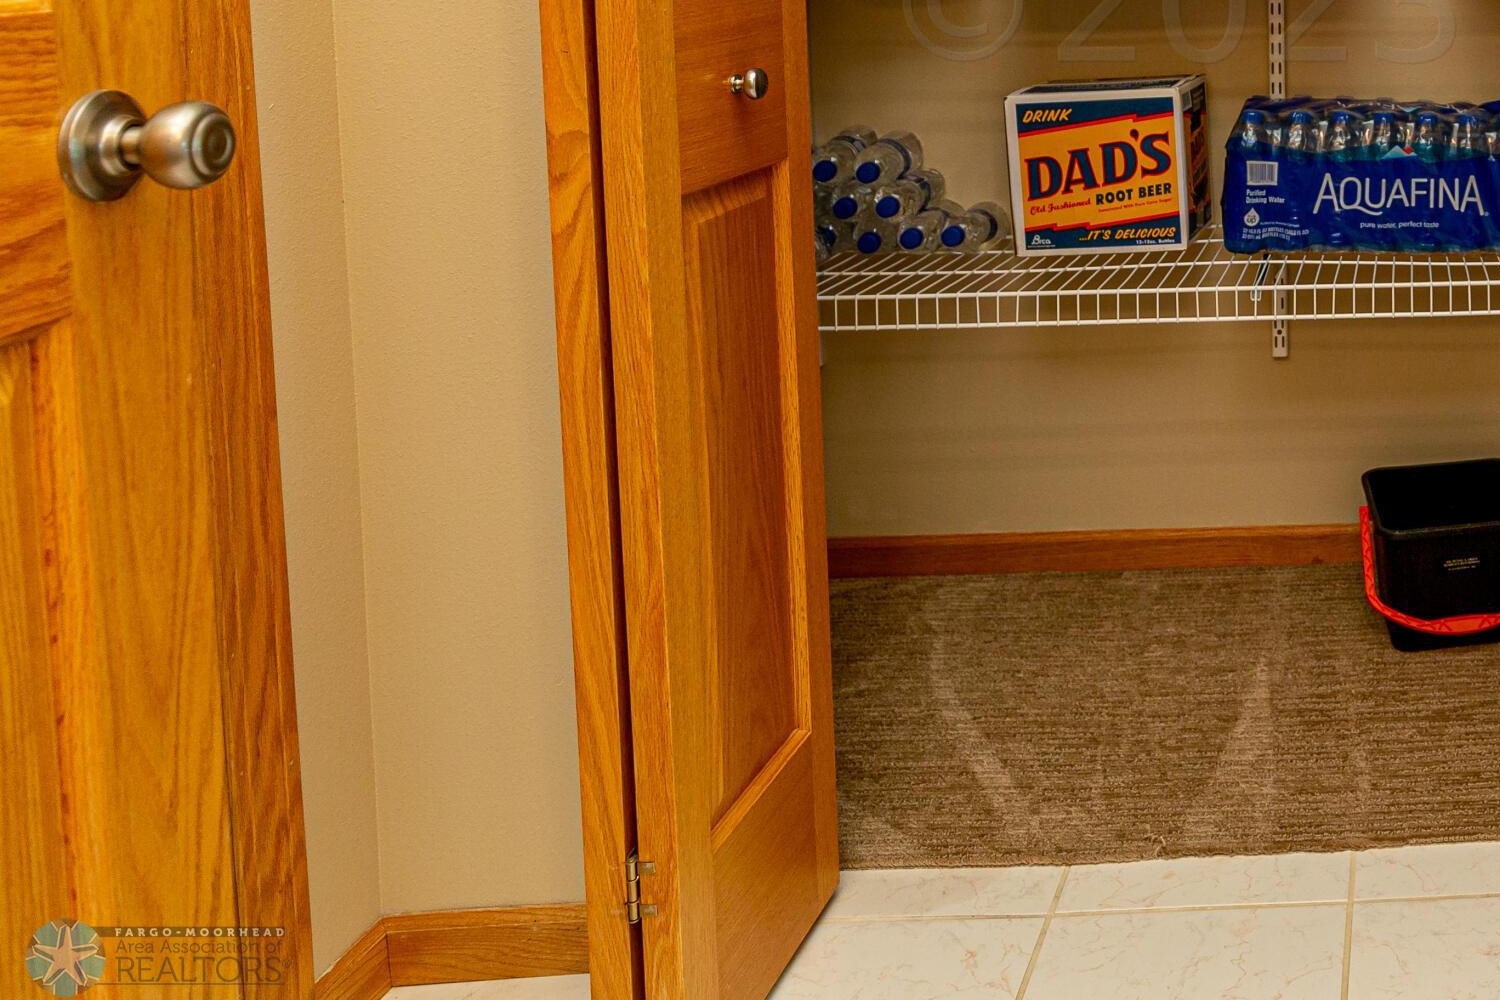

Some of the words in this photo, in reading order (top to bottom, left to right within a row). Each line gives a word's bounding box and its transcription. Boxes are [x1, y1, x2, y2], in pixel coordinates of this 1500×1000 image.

[1022, 108, 1072, 124] DRINK
[1024, 128, 1172, 201] DAD'S
[1096, 189, 1133, 205] ROOT
[1139, 183, 1172, 198] BEER
[1312, 173, 1485, 216] AQUAFINA
[1030, 204, 1046, 215] Old
[1048, 197, 1091, 213] Fashioned
[1115, 227, 1176, 240] DELICIOUS
